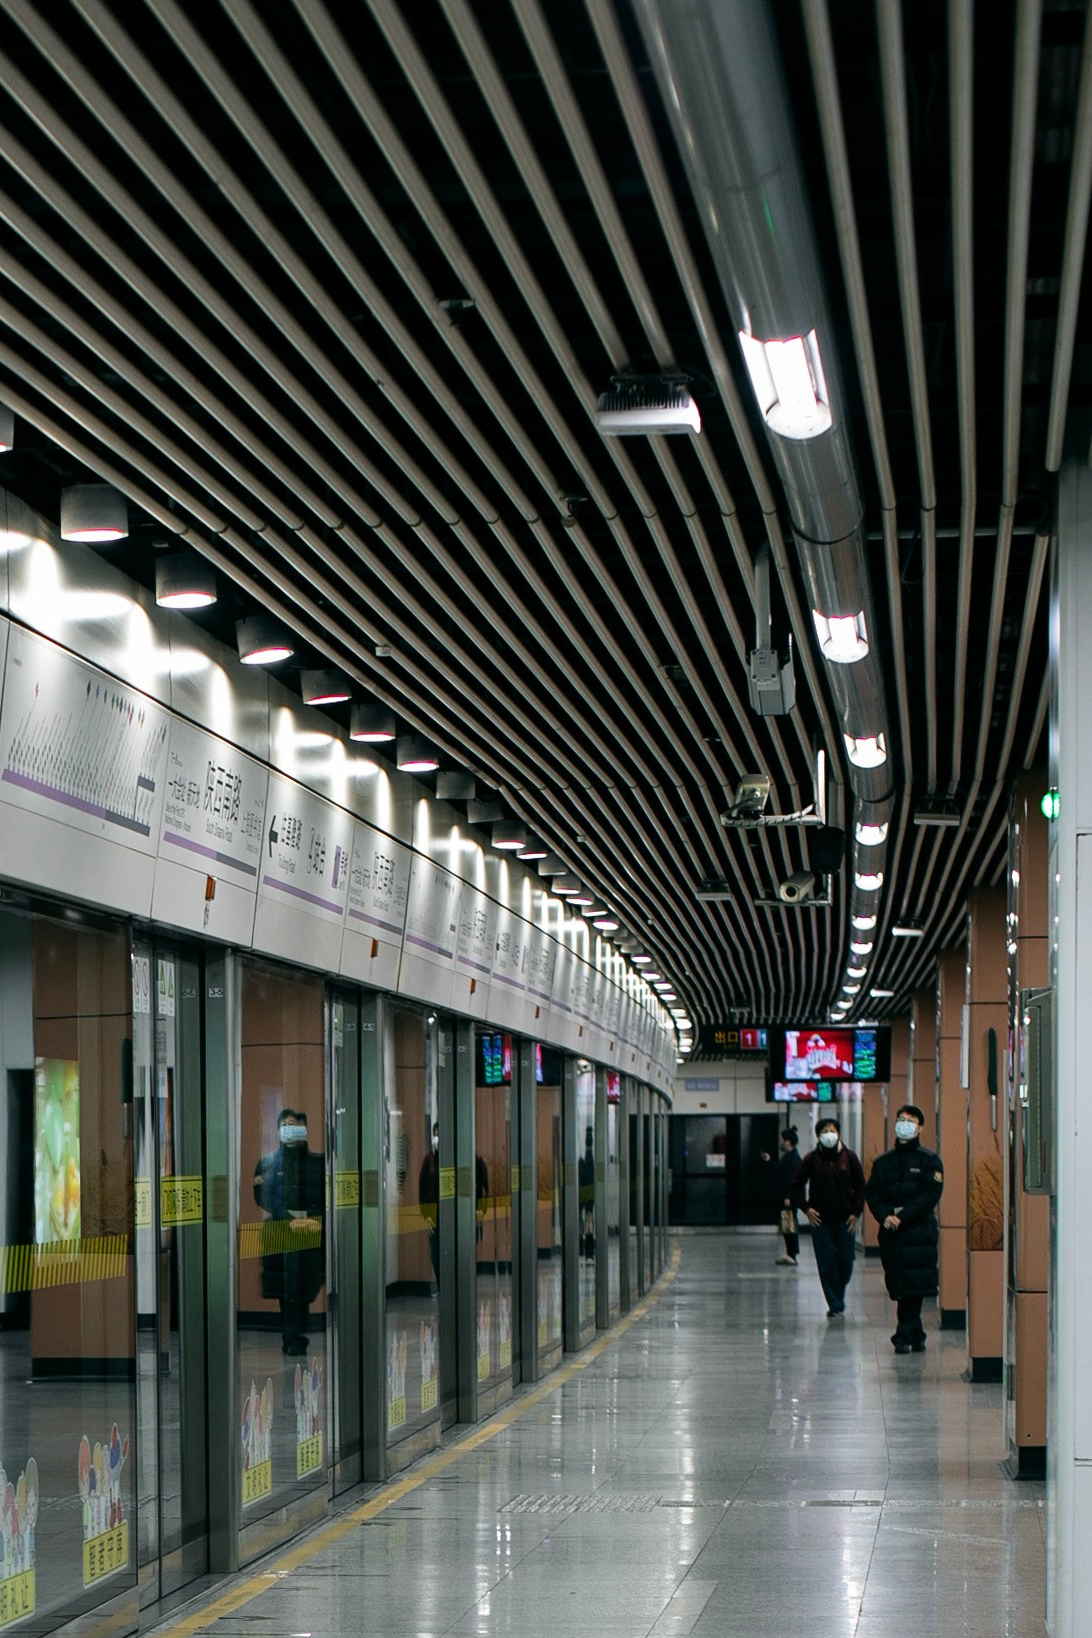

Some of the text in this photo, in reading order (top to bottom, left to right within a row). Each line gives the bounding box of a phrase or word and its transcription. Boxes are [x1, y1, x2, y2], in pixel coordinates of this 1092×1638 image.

[210, 988, 223, 997] 3-5
[714, 1031, 739, 1044] 出口
[745, 1033, 752, 1046] 1
